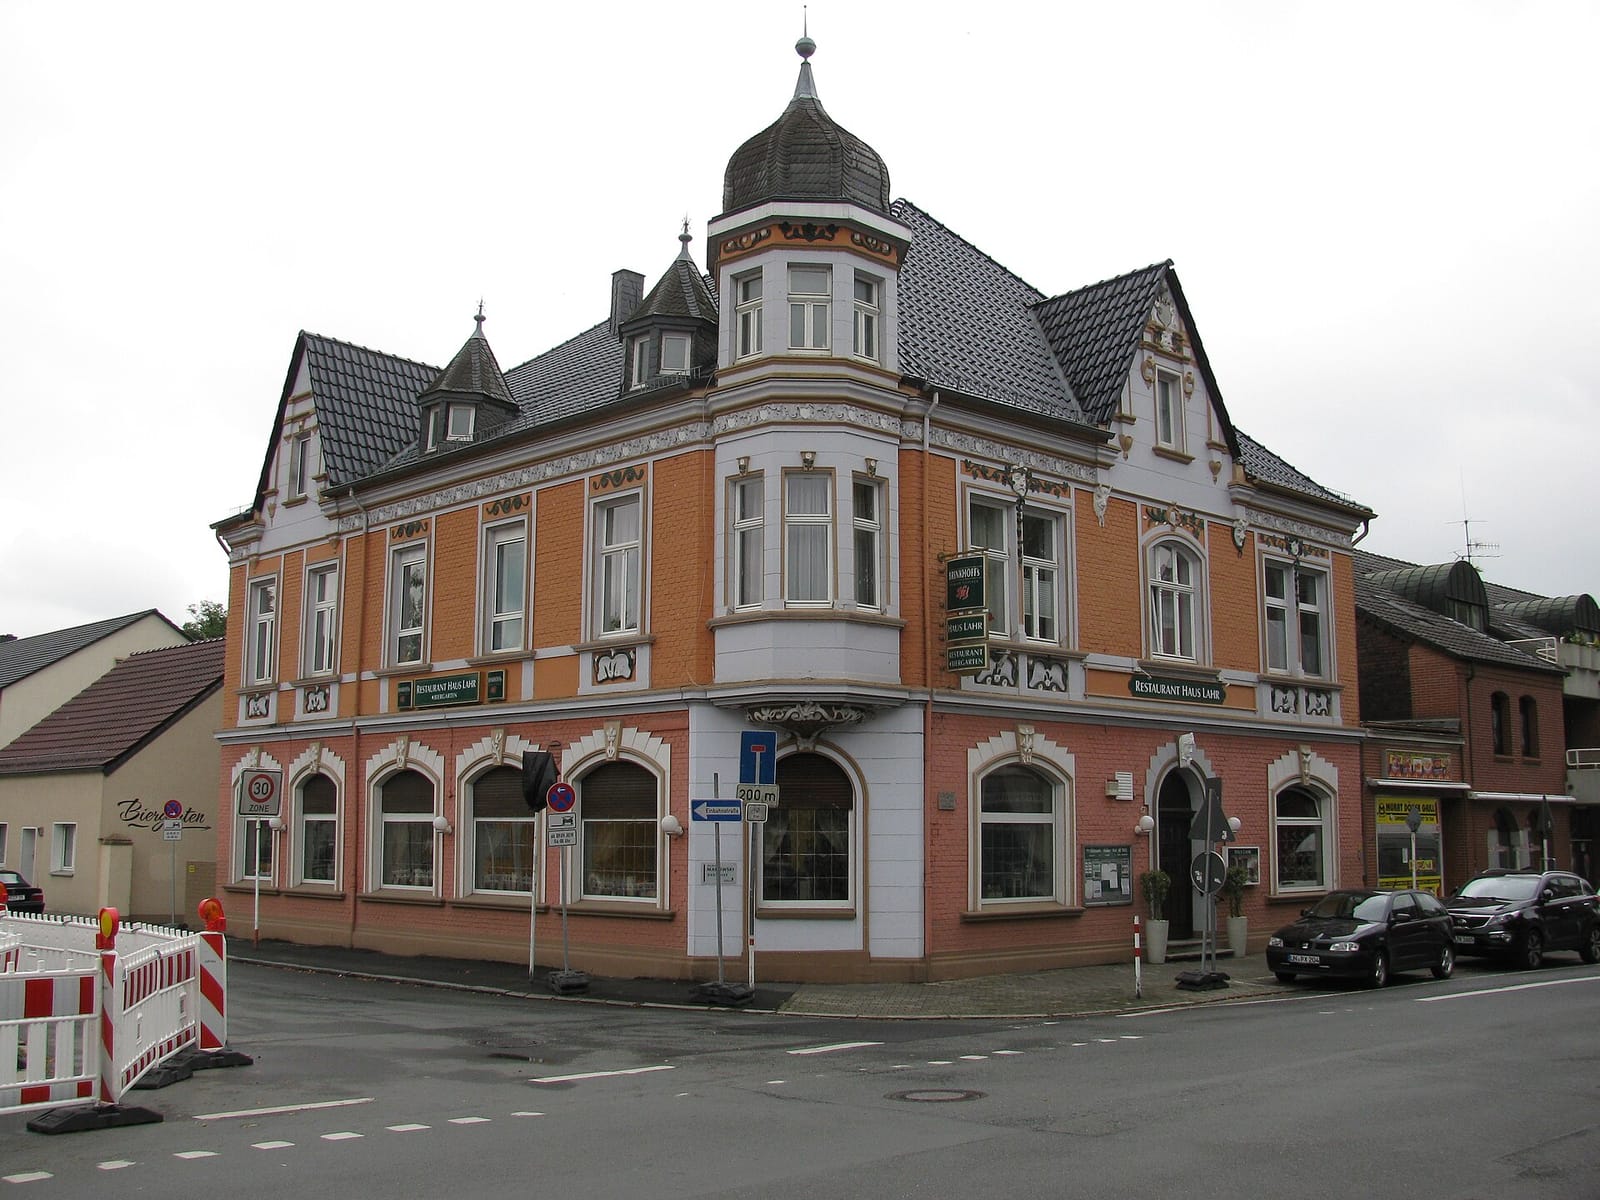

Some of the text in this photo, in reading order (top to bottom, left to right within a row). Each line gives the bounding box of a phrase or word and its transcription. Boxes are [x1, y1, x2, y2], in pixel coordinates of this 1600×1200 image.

[963, 621, 983, 631] LAHR
[948, 648, 983, 659] RESTAURANT
[416, 682, 447, 694] RESTAURANT
[447, 681, 462, 692] HAUS
[462, 679, 477, 690] LAHR
[1135, 680, 1220, 700] RESTAURANT HAUS LAHR
[253, 781, 269, 795] 30
[739, 788, 776, 802] 200 m
[117, 798, 206, 832] Biergten
[248, 804, 270, 813] ZONE
